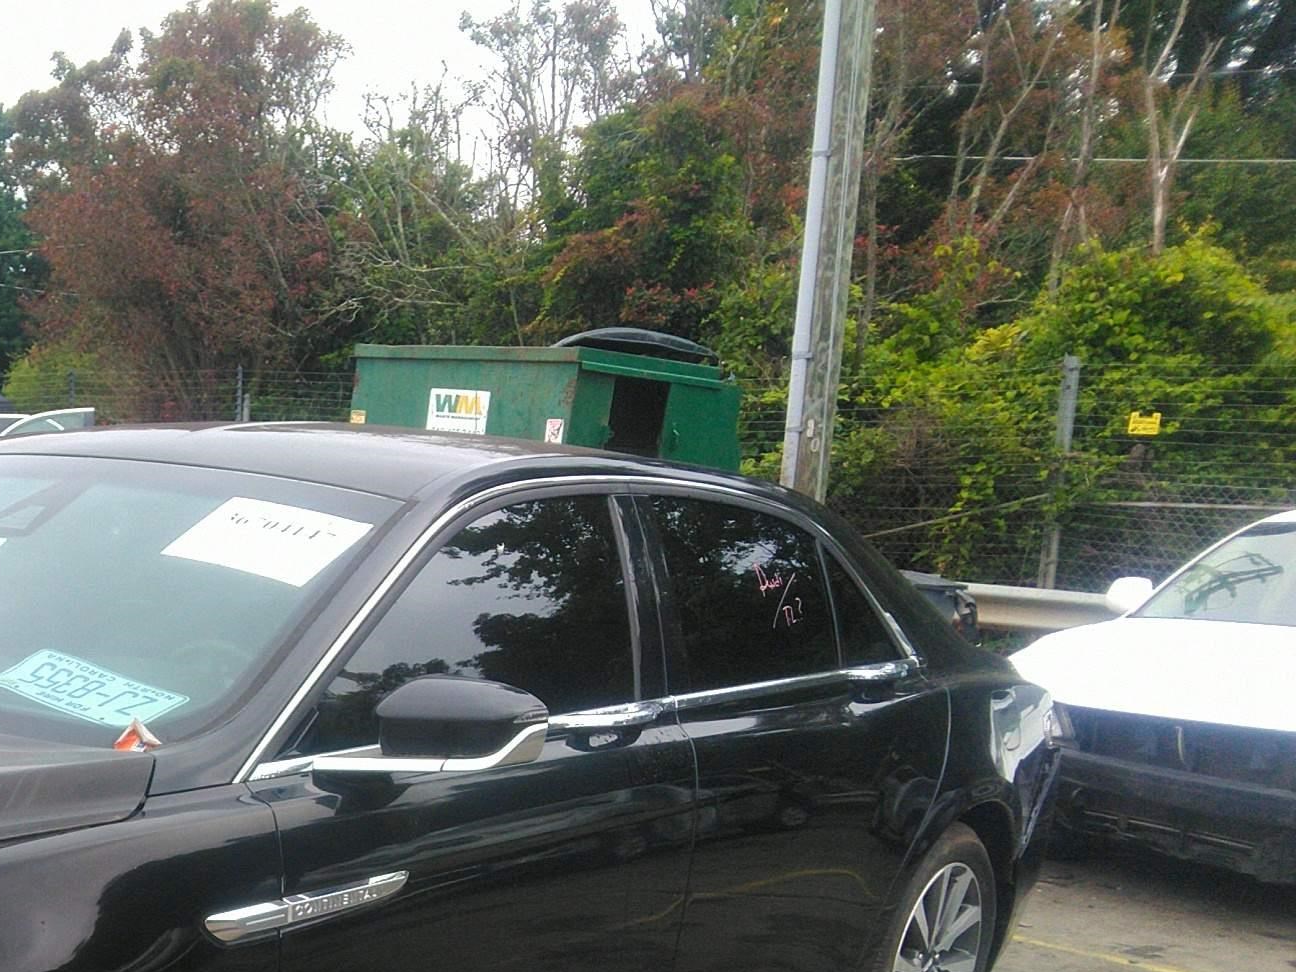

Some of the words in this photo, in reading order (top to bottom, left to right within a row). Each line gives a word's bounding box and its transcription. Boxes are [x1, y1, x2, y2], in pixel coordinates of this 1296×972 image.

[435, 394, 483, 415] WM
[47, 653, 117, 681] CAROLINA
[18, 661, 158, 716] ZJ-8355
[124, 682, 175, 701] NORTH
[65, 701, 92, 712] FOR
